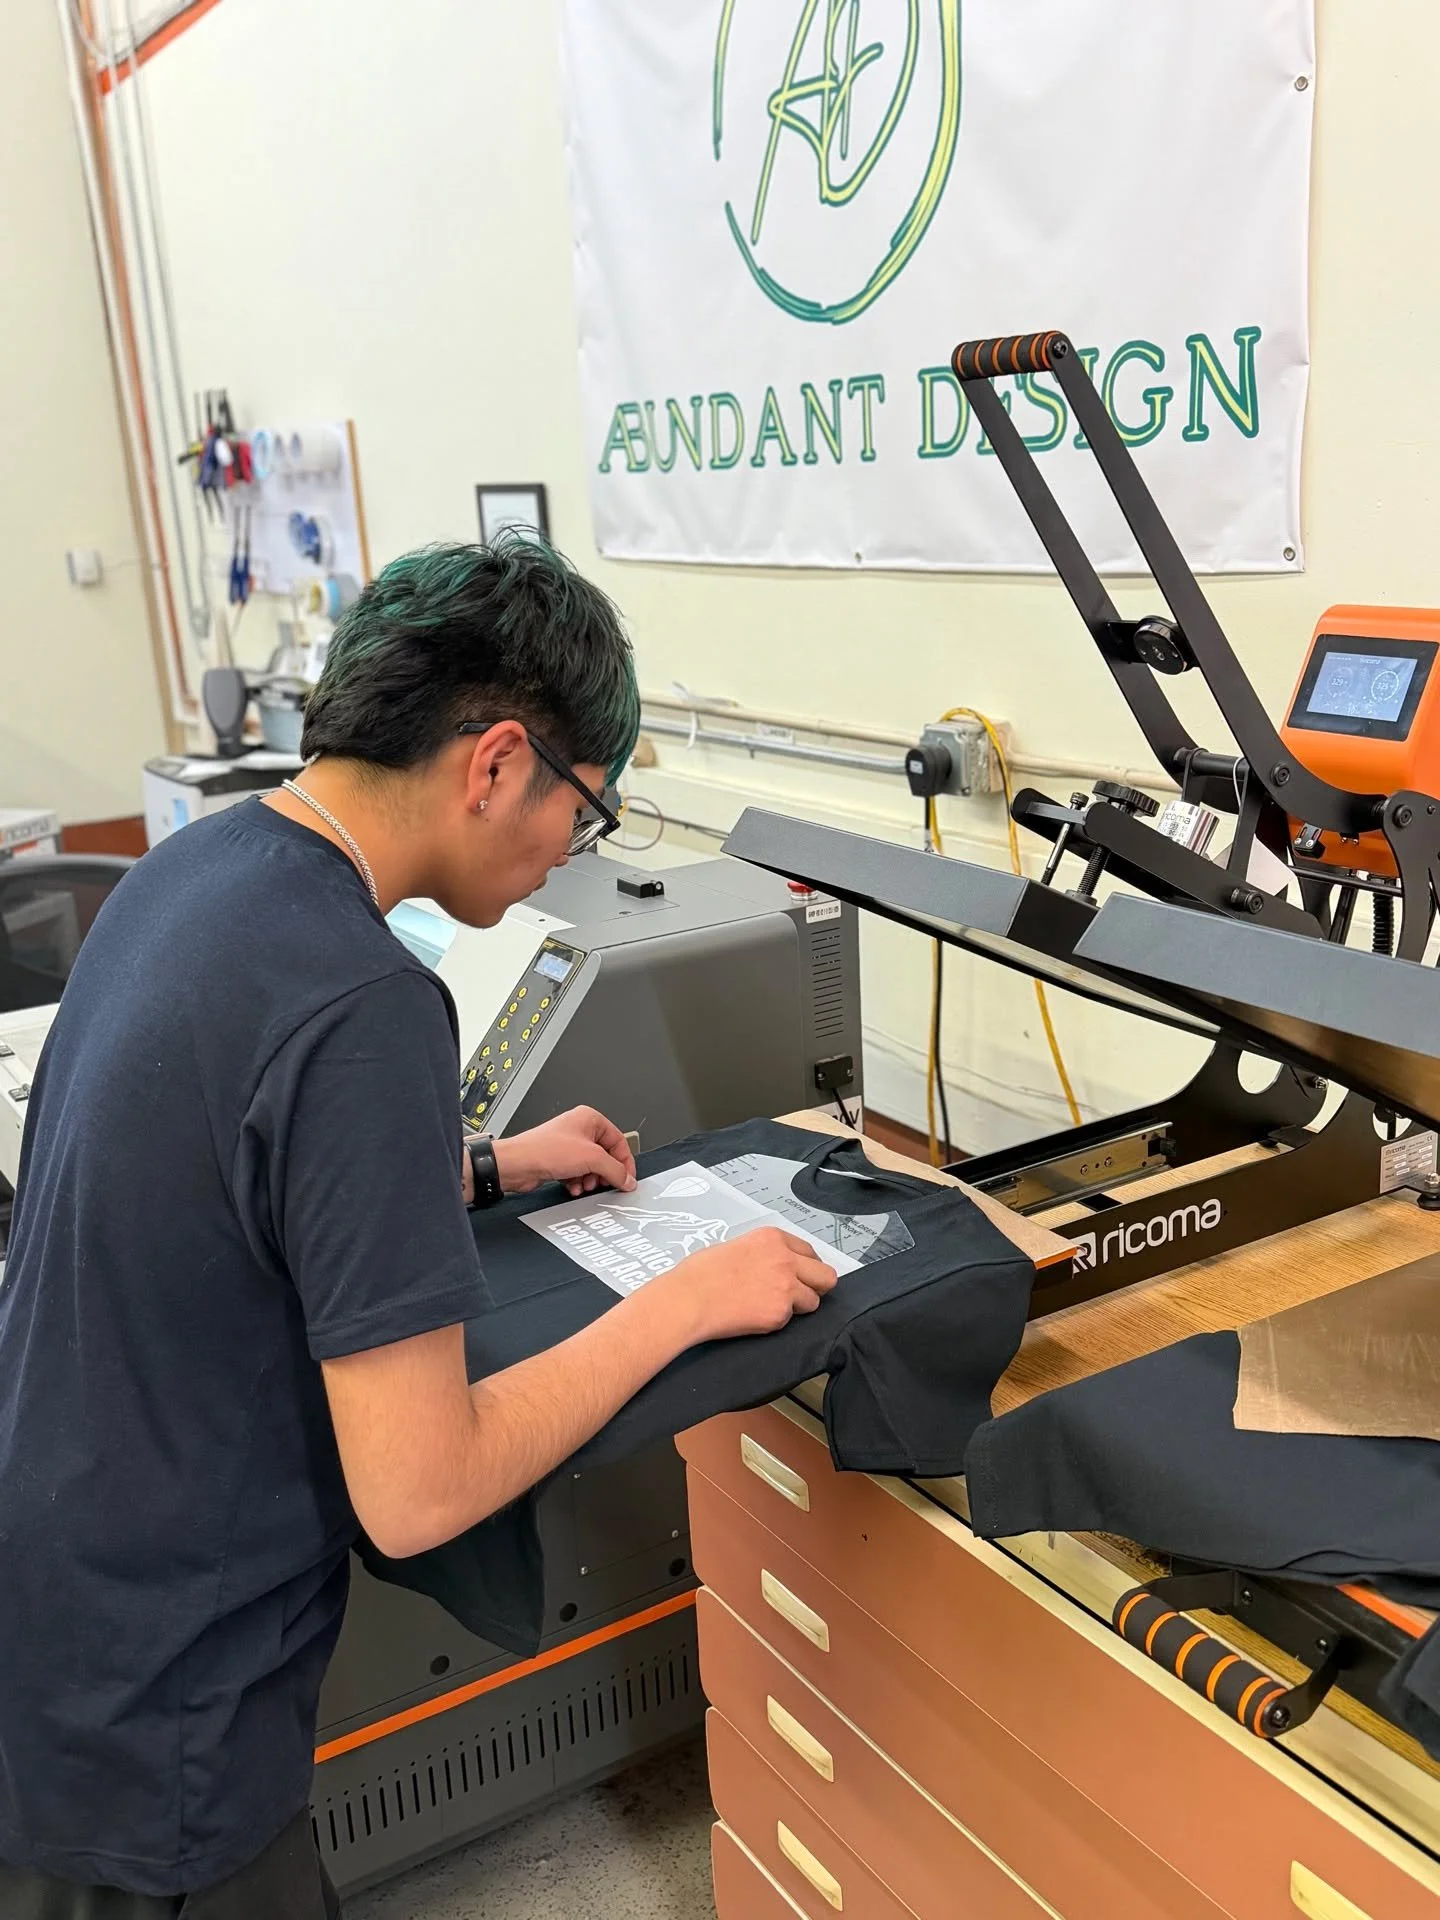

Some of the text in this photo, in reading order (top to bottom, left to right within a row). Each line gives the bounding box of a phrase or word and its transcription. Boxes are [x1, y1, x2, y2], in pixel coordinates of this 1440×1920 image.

[917, 326, 1262, 460] DSGN
[784, 1198, 811, 1214] CENTER
[1102, 1198, 1221, 1264] ricoma
[547, 1218, 627, 1268] Learning
[580, 1210, 676, 1276] New Mexic
